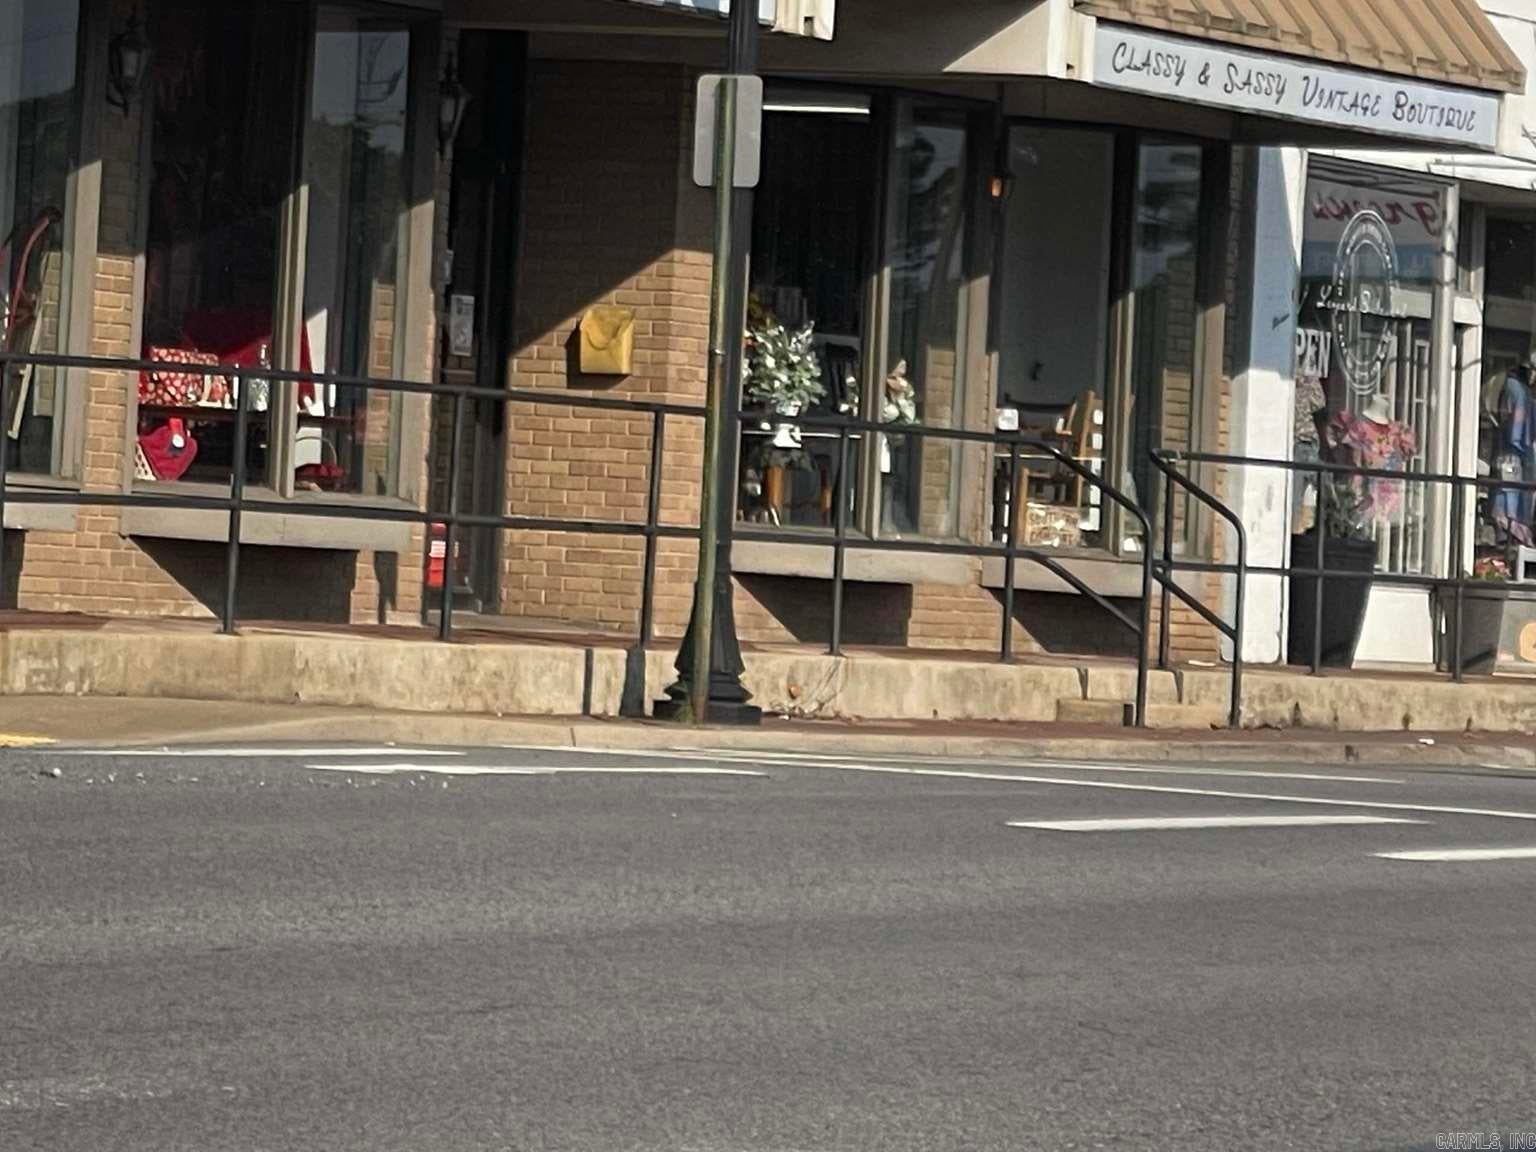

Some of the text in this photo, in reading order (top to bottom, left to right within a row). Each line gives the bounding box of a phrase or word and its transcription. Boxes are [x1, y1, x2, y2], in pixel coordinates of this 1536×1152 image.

[1112, 42, 1477, 132] CLASSY & SASSY VINTAGE BOUTIQUE
[1295, 327, 1332, 378] PEN
